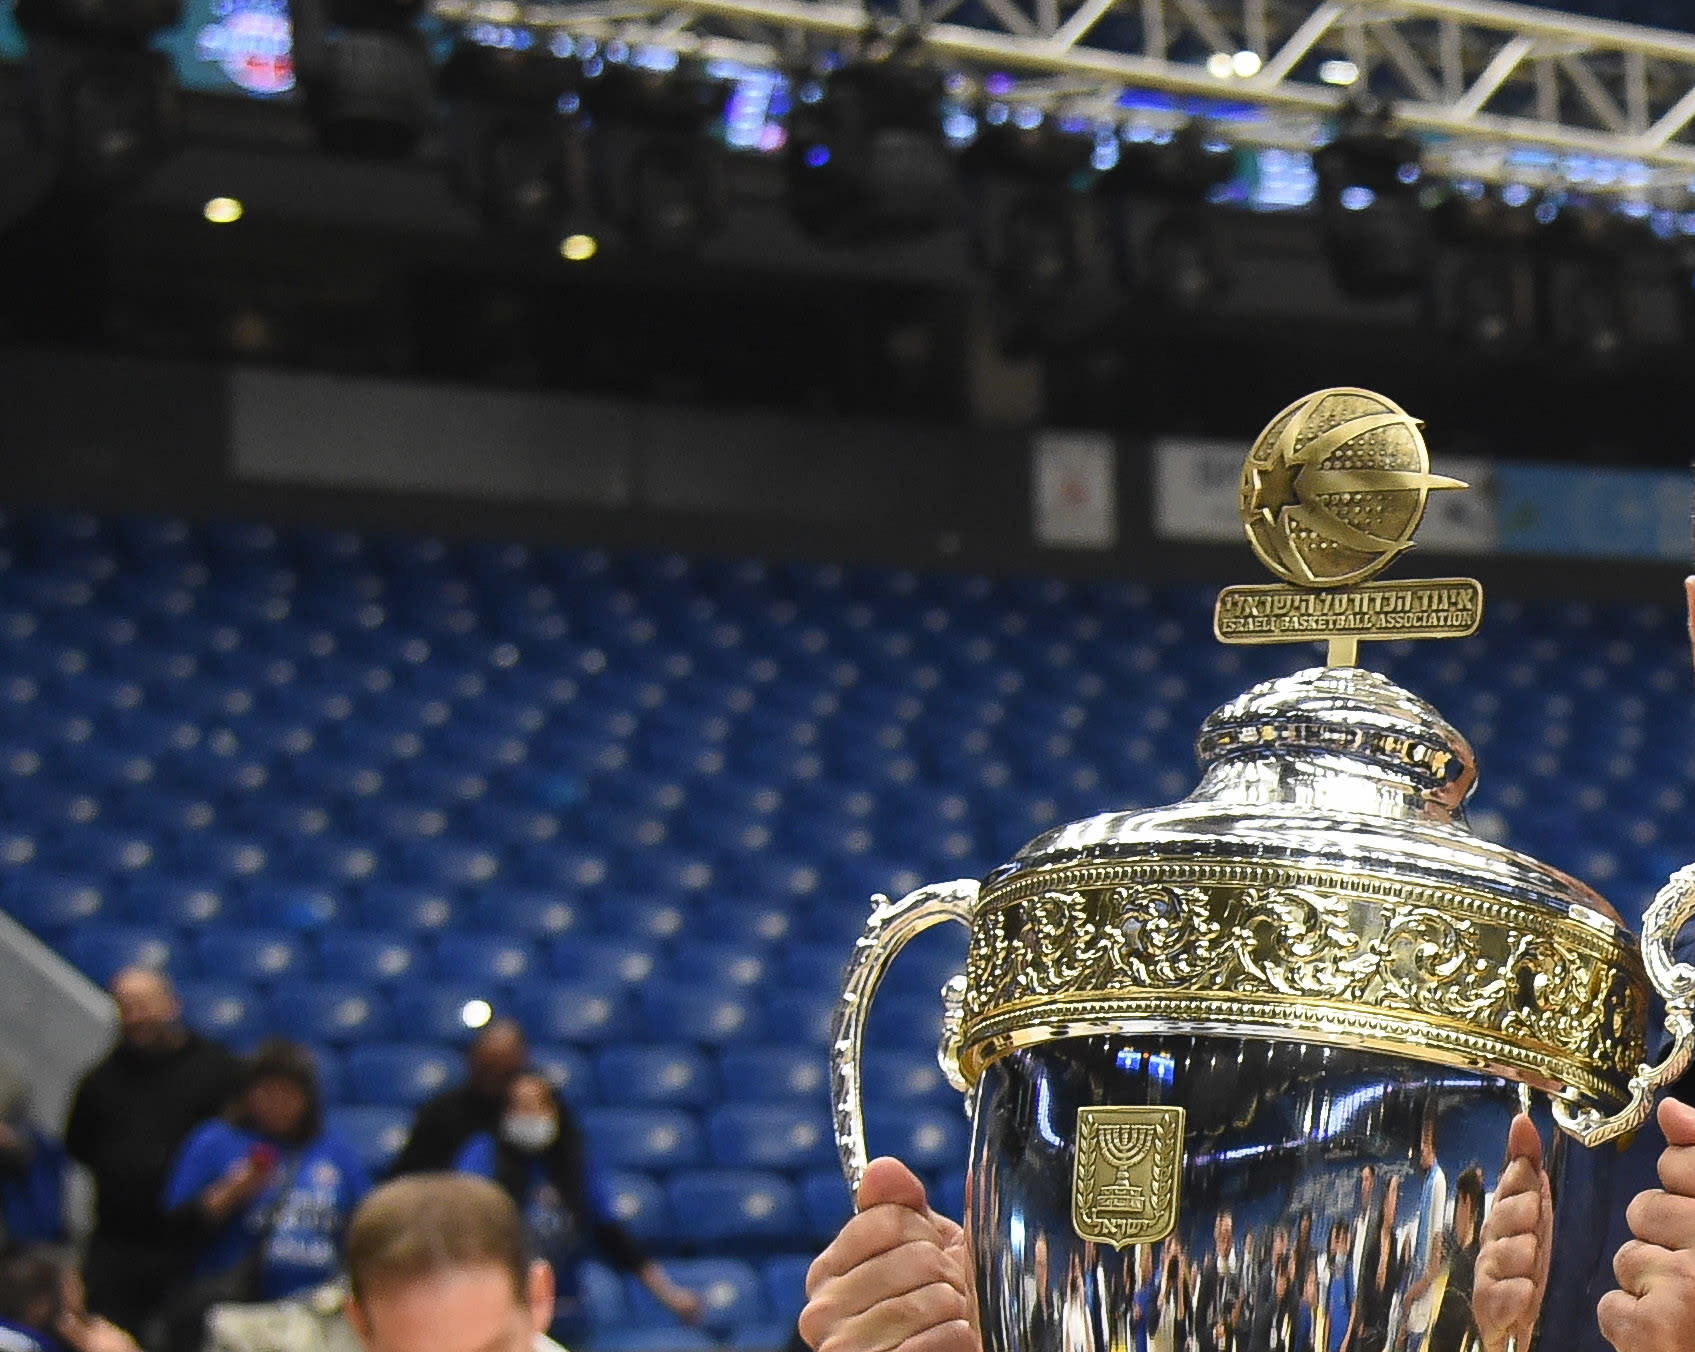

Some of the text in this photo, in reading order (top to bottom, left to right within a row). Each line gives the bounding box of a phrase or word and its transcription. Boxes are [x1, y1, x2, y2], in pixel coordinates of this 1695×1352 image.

[1225, 588, 1473, 617] איגוד הכדורסל הישראלי
[1222, 610, 1473, 632] ISRAELI BASKETBALL ASSOCIATION
